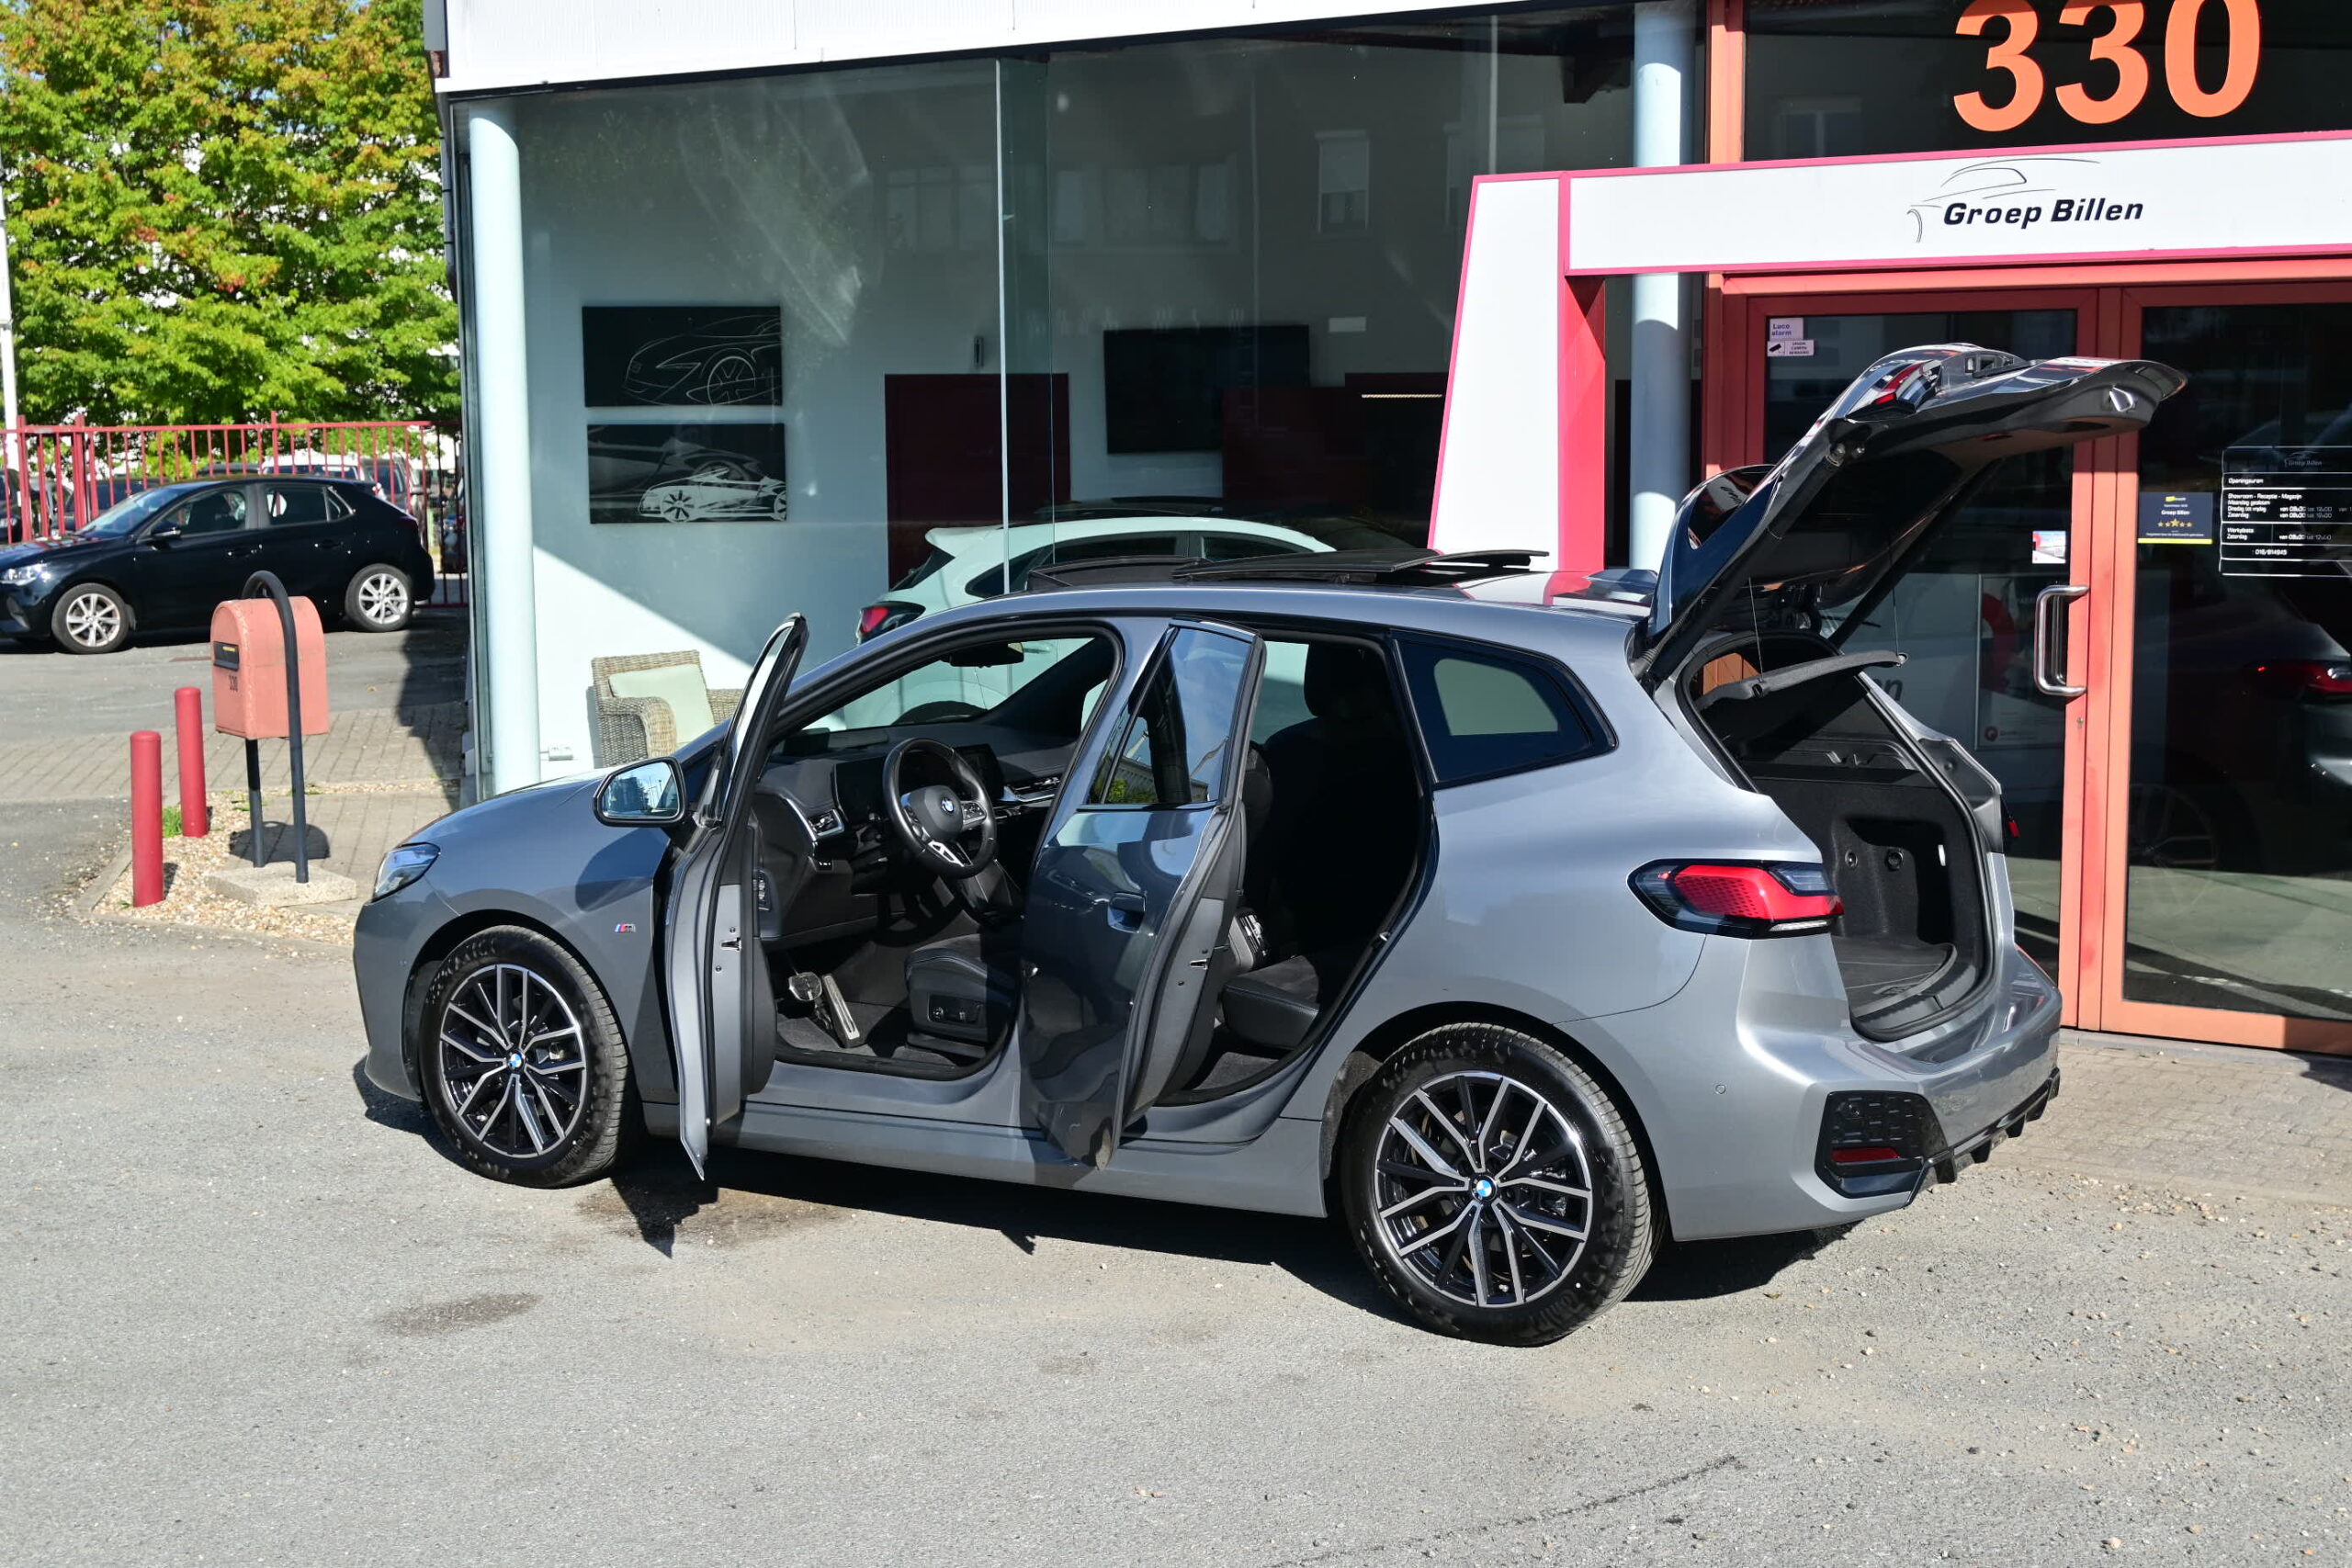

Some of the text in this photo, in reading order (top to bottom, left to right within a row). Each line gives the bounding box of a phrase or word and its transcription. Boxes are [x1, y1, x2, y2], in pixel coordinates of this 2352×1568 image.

[1953, 0, 2261, 131] 330
[1943, 197, 2143, 229] Groep Billen
